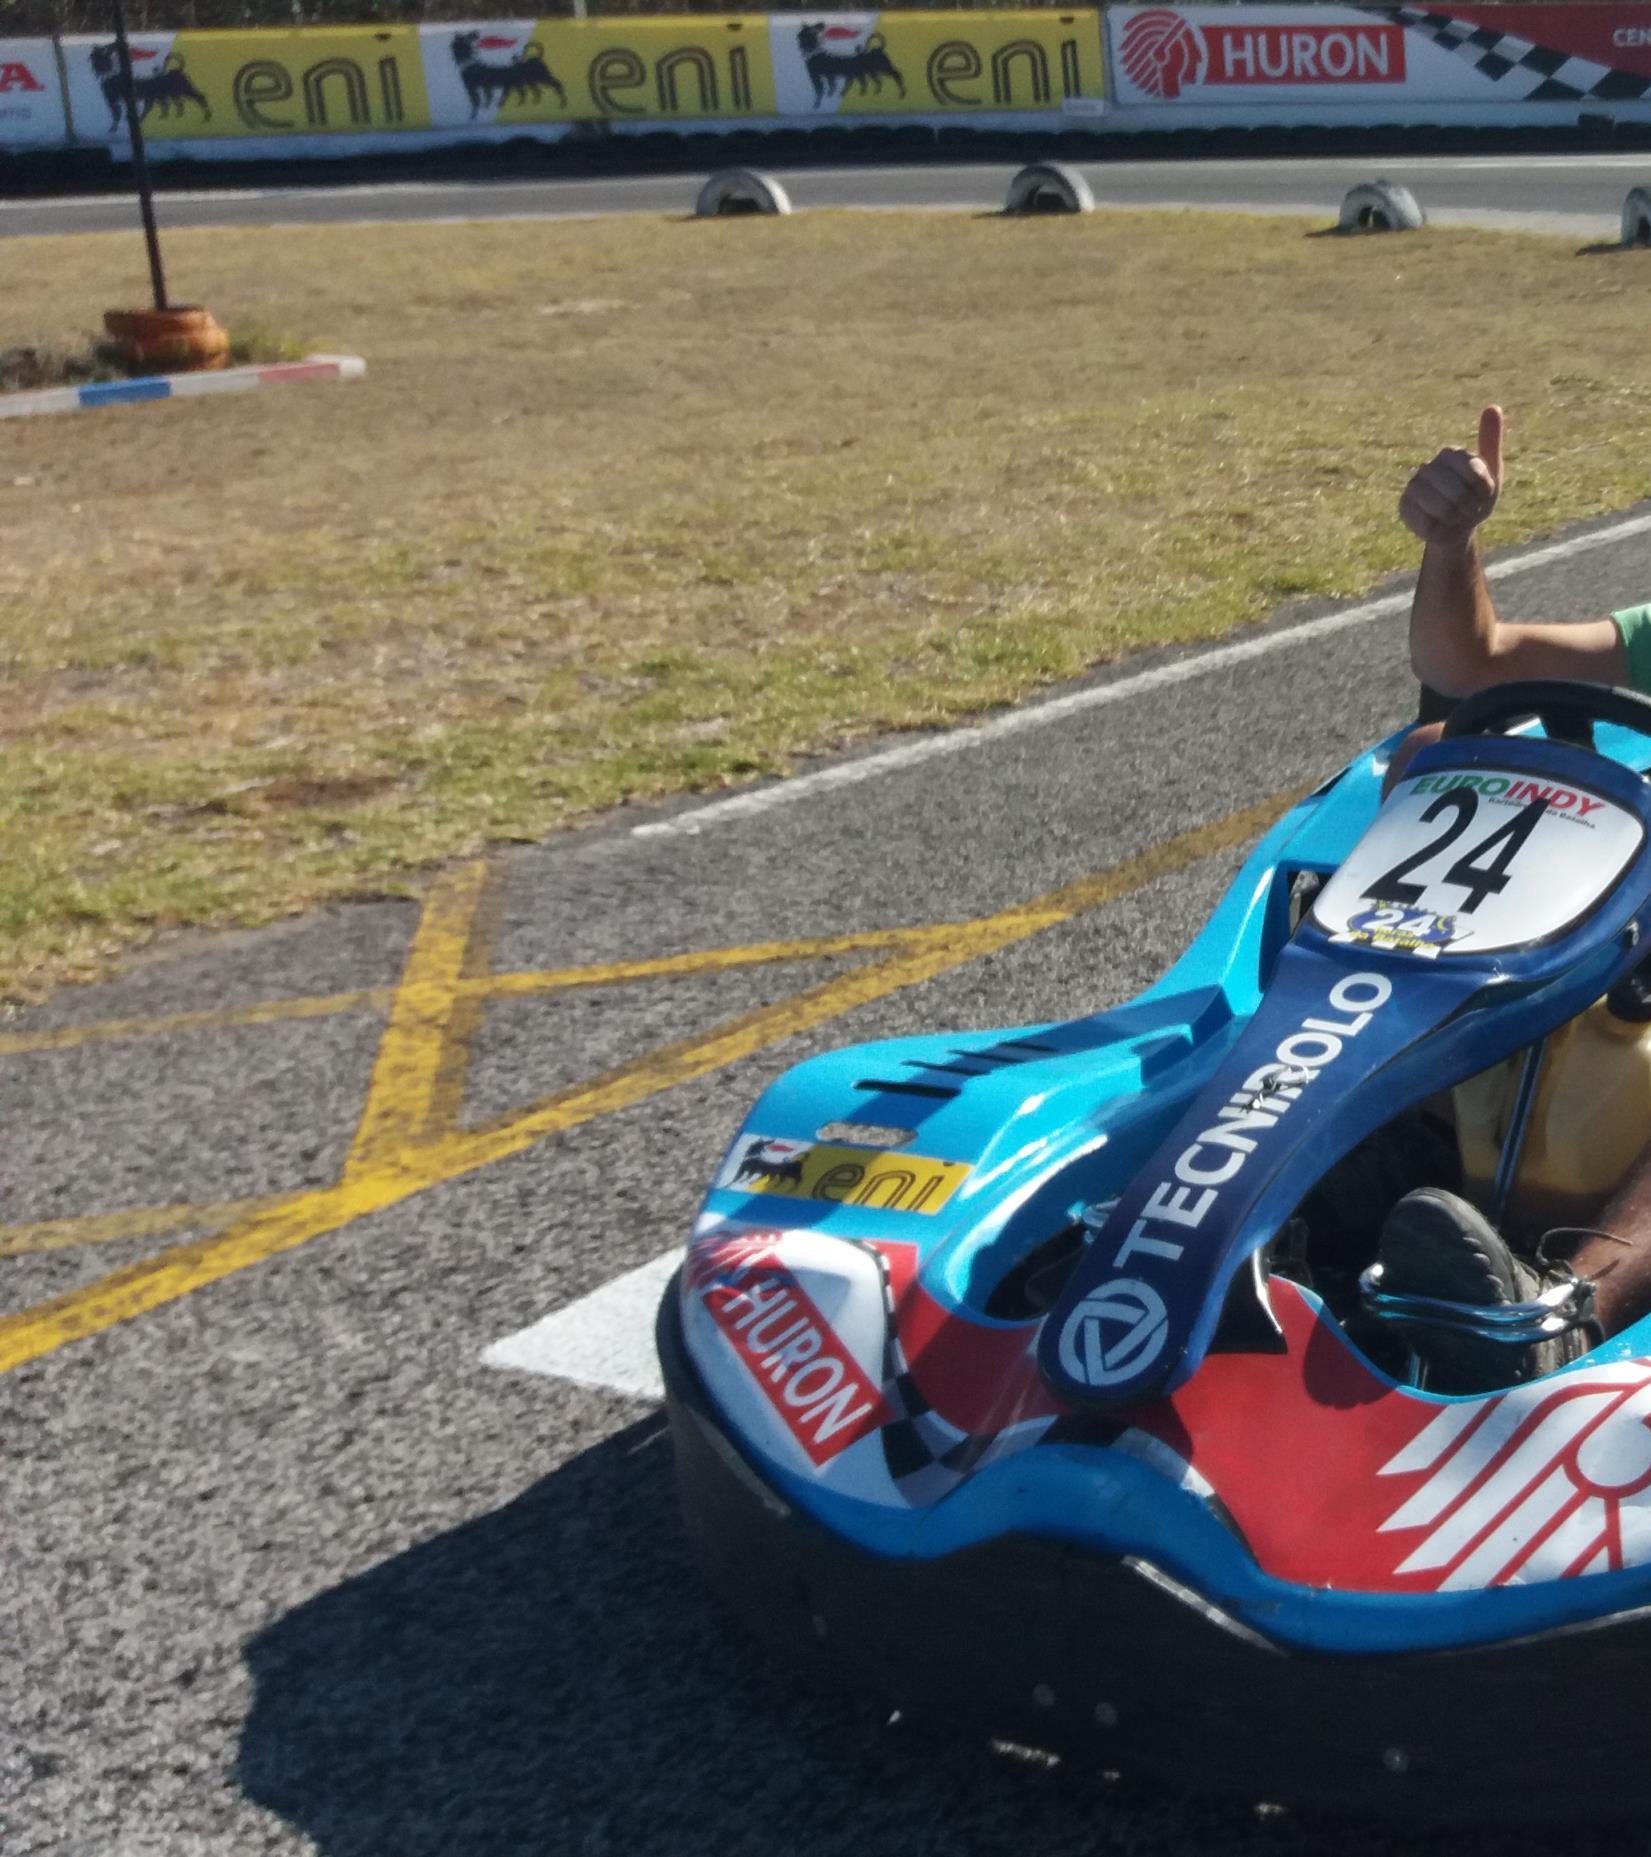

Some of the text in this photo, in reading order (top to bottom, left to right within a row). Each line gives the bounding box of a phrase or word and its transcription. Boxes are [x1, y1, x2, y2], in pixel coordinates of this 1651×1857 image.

[234, 33, 404, 129] eni
[589, 23, 752, 113] eni
[927, 17, 1083, 104] eni
[1223, 31, 1389, 78] HURON
[1409, 775, 1606, 817] EUROINDY
[1359, 785, 1552, 915] 24
[1361, 908, 1438, 937] 24
[1113, 971, 1393, 1269] TECNIROLO
[811, 1159, 955, 1214] eni
[723, 1277, 874, 1446] HURON
